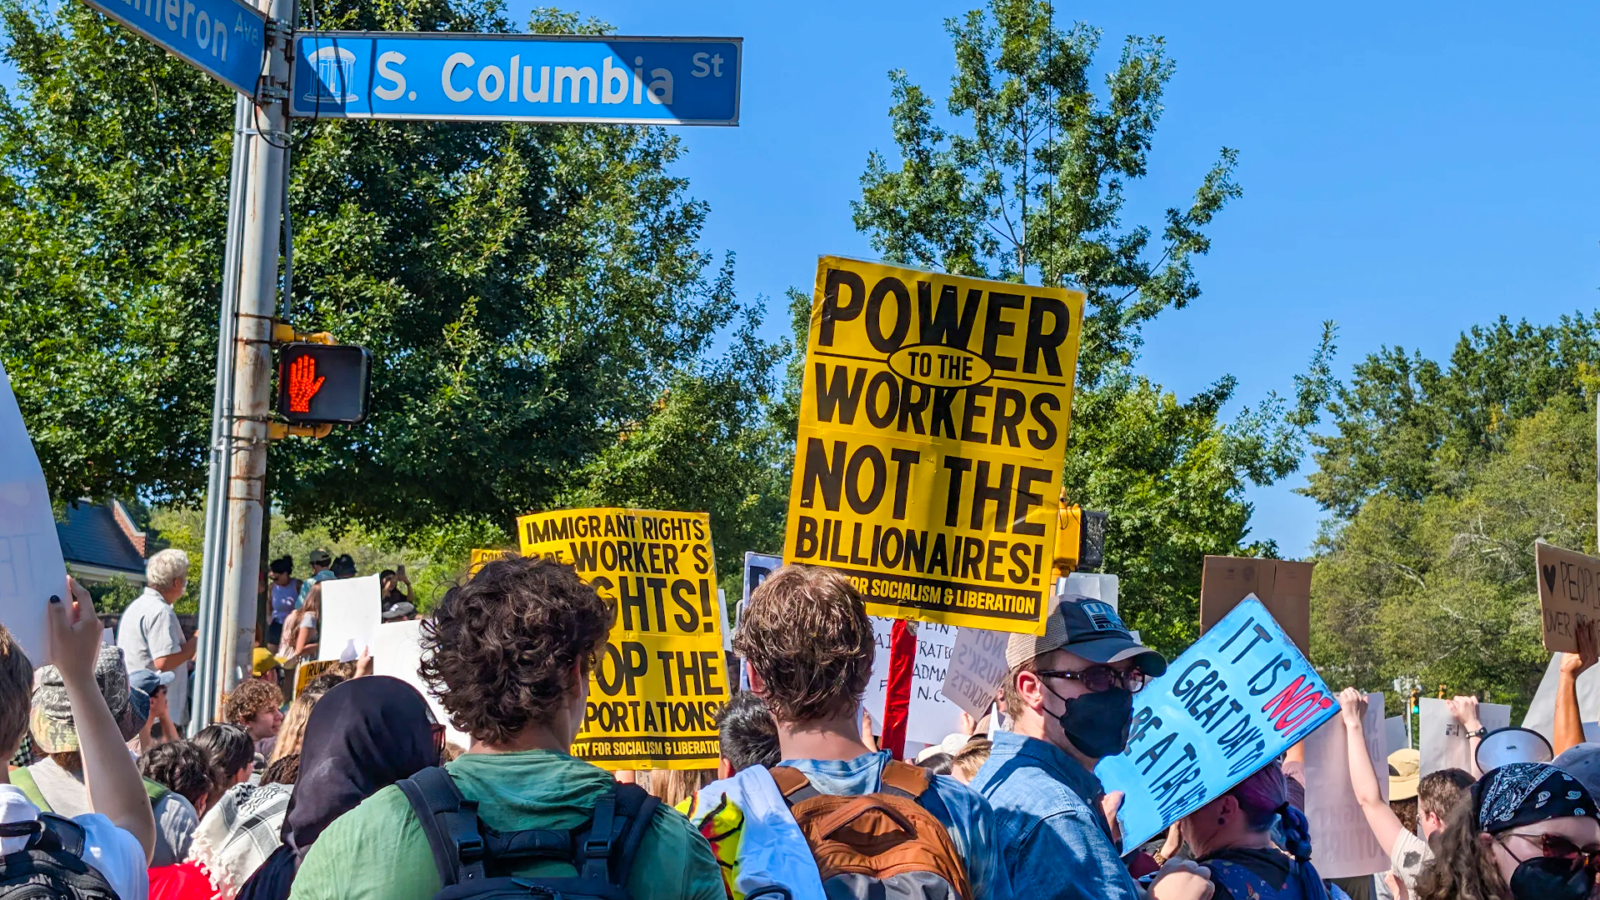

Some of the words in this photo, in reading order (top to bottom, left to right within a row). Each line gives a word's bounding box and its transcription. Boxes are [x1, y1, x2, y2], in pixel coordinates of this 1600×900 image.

[233, 11, 259, 47] Ave
[373, 51, 417, 102] S.
[441, 51, 675, 105] Columbia
[690, 51, 724, 78] St
[818, 268, 1070, 377] POWER
[908, 352, 932, 378] TO
[937, 354, 973, 382] THE
[815, 362, 1061, 450] WORKERS
[800, 437, 920, 520] NOT
[944, 455, 1053, 537] THE
[526, 513, 636, 545] IMMIGRANT
[642, 516, 705, 542] RIGHTS
[795, 515, 1044, 587] BILLIONAIRES!
[569, 540, 708, 576] WORKER'S
[590, 575, 714, 634] GHTS!
[871, 579, 942, 604] SOCIALISM
[944, 588, 955, 605] &
[955, 589, 1036, 615] LIBERATION
[1218, 616, 1273, 665] IT
[1544, 608, 1573, 639] OVER
[656, 650, 723, 696] THE
[917, 686, 946, 703] N.C.
[1172, 658, 1244, 734] GREAT
[1247, 652, 1292, 696] IS
[1261, 673, 1334, 738] NOT
[570, 741, 590, 757] RTY
[592, 741, 612, 756] FOR
[613, 740, 664, 756] SOCIALISM
[664, 741, 672, 755] &
[673, 740, 720, 755] LIBERATIO
[1134, 732, 1180, 776] A
[1217, 714, 1266, 760] DAY
[1226, 739, 1266, 777] TO
[1149, 743, 1202, 811] TAR
